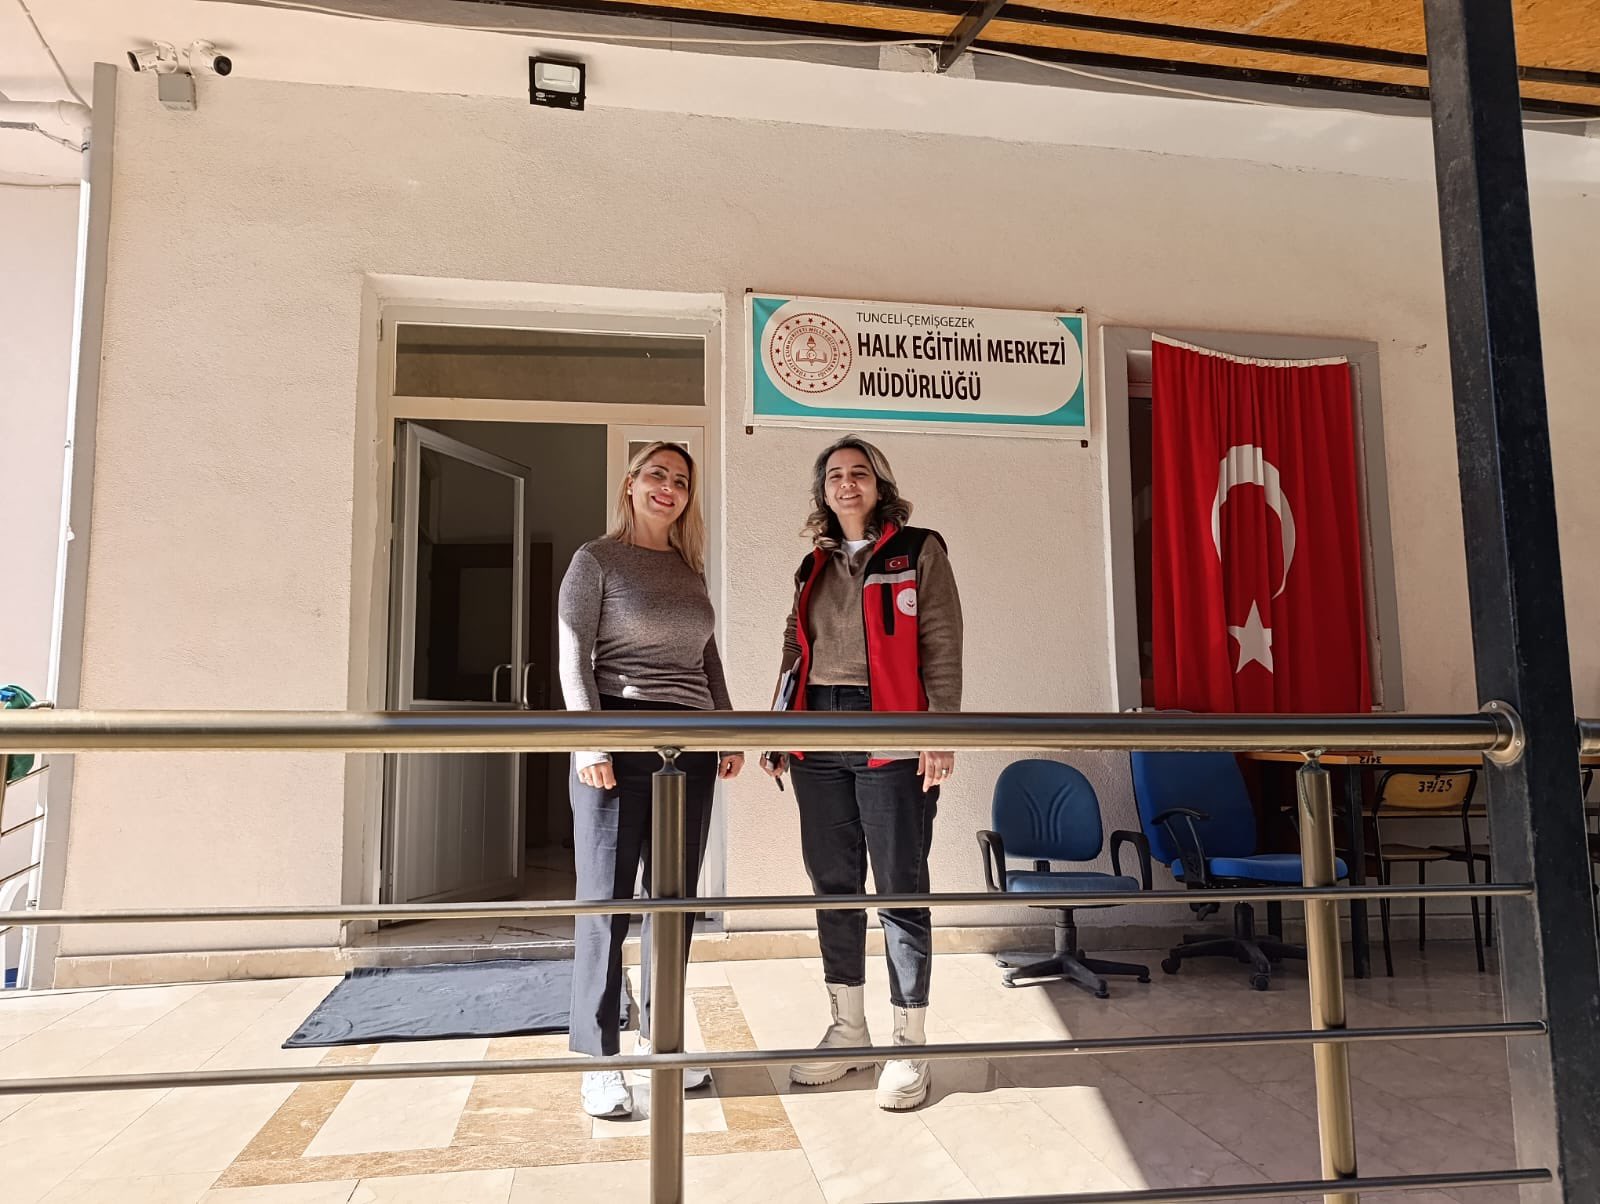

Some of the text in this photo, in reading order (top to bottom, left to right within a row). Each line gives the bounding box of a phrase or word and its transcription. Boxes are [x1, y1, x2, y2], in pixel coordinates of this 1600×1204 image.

[856, 311, 975, 329] TUNCELİ-ÇEMİŞGEZEK
[857, 330, 1066, 365] HALK EĞİTİMİ MERKEZİ
[859, 367, 982, 401] MÜDÜRLÜĞÜ
[1417, 778, 1453, 793] 37/25
